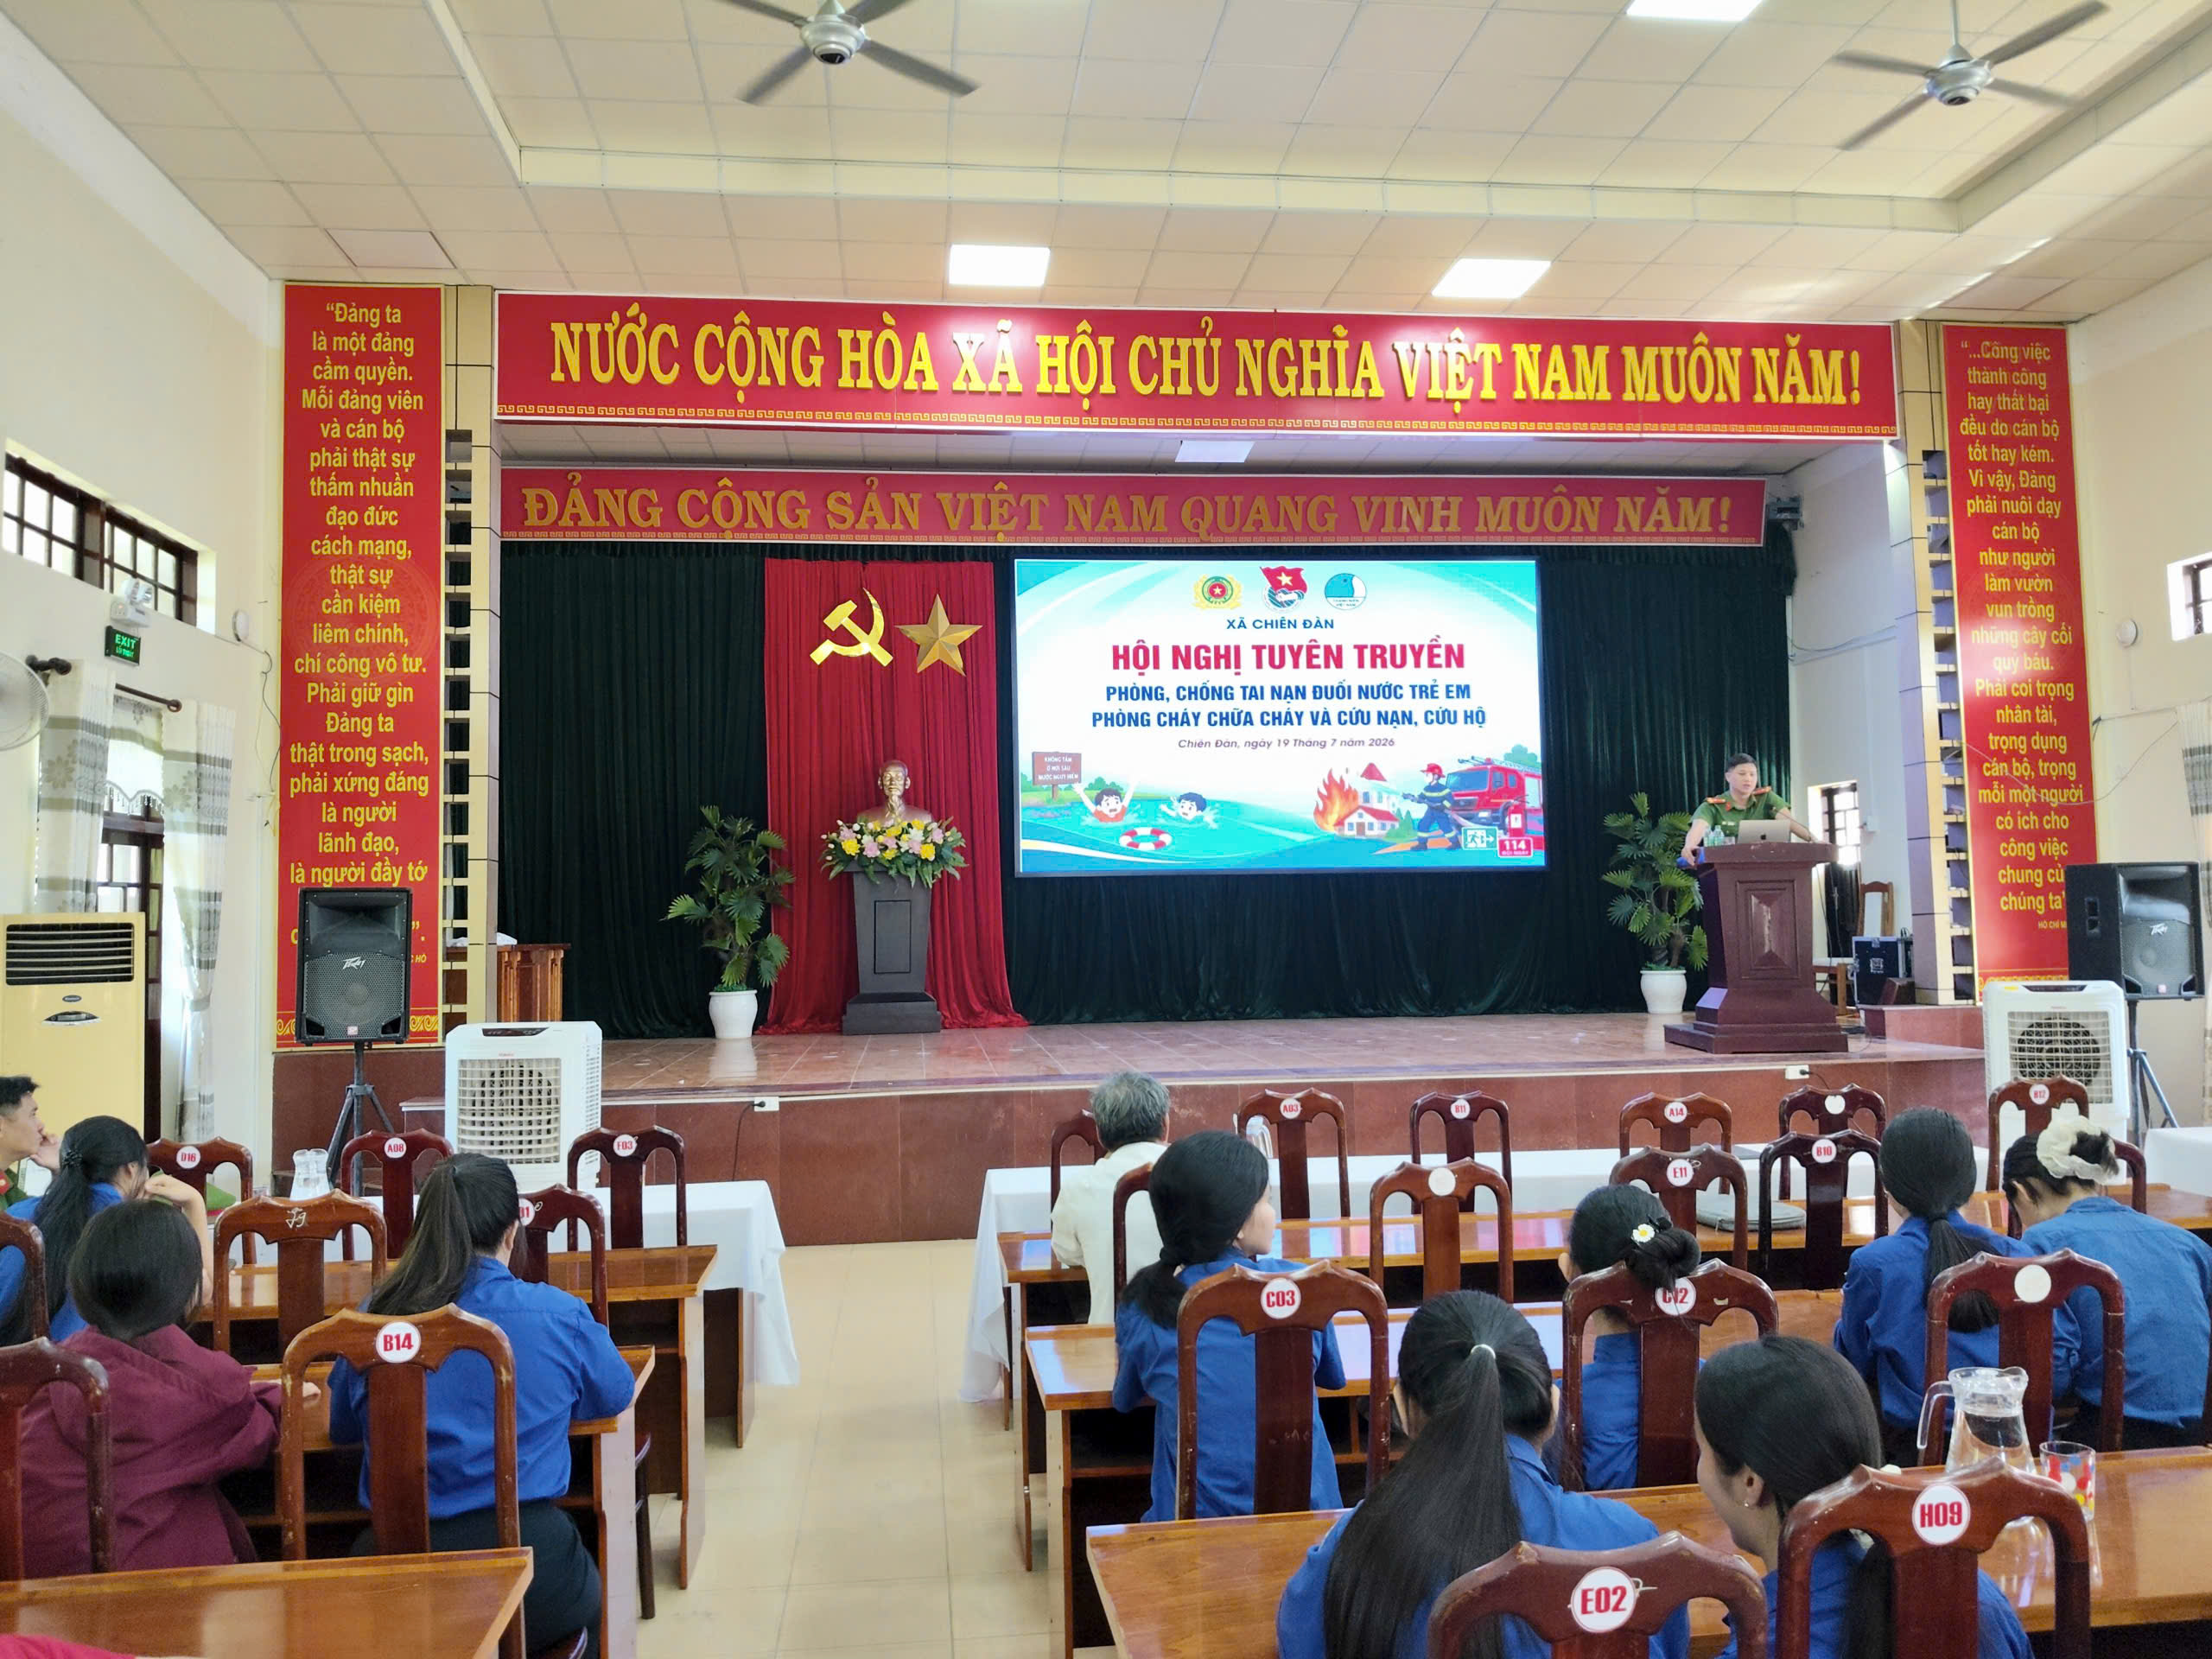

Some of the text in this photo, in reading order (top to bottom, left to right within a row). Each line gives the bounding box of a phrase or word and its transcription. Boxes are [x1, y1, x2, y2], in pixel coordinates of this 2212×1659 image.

[385, 305, 401, 323] ta
[313, 331, 414, 357] là một đảng
[313, 356, 413, 385] cầm quyền.
[550, 303, 1860, 414] NƯỚC CỘNG HÒA XÃ HỘI CHỦ NGHĨA VIỆT NAM MUÔN NĂM!
[302, 385, 423, 414] Mỗi đảng viên
[321, 418, 404, 443] và cán bộ
[310, 446, 416, 473] phải thật sự
[310, 472, 414, 497] thấm nhuần
[326, 505, 397, 530] đạo đức
[522, 473, 1732, 542] ĐẢNG CỘNG SẢN VIỆT NAM QUANG VINH MUÔN NĂM!
[1992, 521, 2039, 543] cán bộ
[311, 535, 353, 556] cách
[1980, 548, 2055, 569] như người
[330, 564, 393, 588] thật sự
[1986, 574, 2053, 592] làm vườn
[359, 594, 400, 618] kiệm
[1986, 596, 2055, 622] vun trồng
[314, 623, 408, 646] liêm chính,
[1226, 616, 1334, 629] XÃ CHIÊN ĐÀN
[115, 633, 136, 649] EXIT
[295, 652, 426, 677] chí công vô tư.
[1112, 635, 1464, 677] HỘI NGHỊ TUYÊN TRUYỀN
[308, 683, 413, 707] Phải giữ gìn
[1106, 679, 1470, 703] PHÒNG, CHỐNG TAI NẠN ĐUỐI NƯỚC TRẺ EM
[1975, 678, 2074, 702] Phải coi trọng
[326, 712, 393, 738] Đảng ta
[1092, 707, 1486, 728] PHÒNG CHÁY CHỮA CHÁY VÀ CỨU NẠN, CỨU HỘ
[1996, 705, 2031, 723] nhân
[290, 741, 429, 767] thật trong sạch,
[1244, 739, 1273, 750] ngày
[1276, 739, 1289, 748] 19
[1293, 739, 1326, 749] Tháng
[1331, 739, 1337, 747] 7
[1369, 738, 1395, 747] 2026
[1989, 732, 2067, 754] trọng dụng
[1983, 758, 2007, 777] cán
[2038, 760, 2076, 780] trọng
[290, 771, 429, 798] phải xứng đáng
[1979, 781, 2083, 807] mỗi một người
[321, 802, 397, 827] là người
[1996, 810, 2013, 830] có
[2043, 810, 2069, 830] cho
[318, 832, 399, 856] lãnh đạo,
[1504, 840, 1526, 850] 114
[1999, 837, 2069, 861] công việc
[290, 863, 304, 883] là
[311, 861, 365, 887] người
[408, 861, 429, 881] tớ
[1998, 863, 2066, 887] chung củ
[1282, 1103, 1299, 1113] A03
[1669, 1108, 1684, 1117] A14
[387, 1144, 404, 1153] A08
[617, 1141, 633, 1150] F03
[1817, 1146, 1832, 1156] B10
[1674, 1167, 1688, 1179] E11
[1266, 1291, 1295, 1307] C03
[383, 1333, 414, 1351] B14
[1921, 1503, 1962, 1528] H09
[1580, 1587, 1627, 1614] E02
